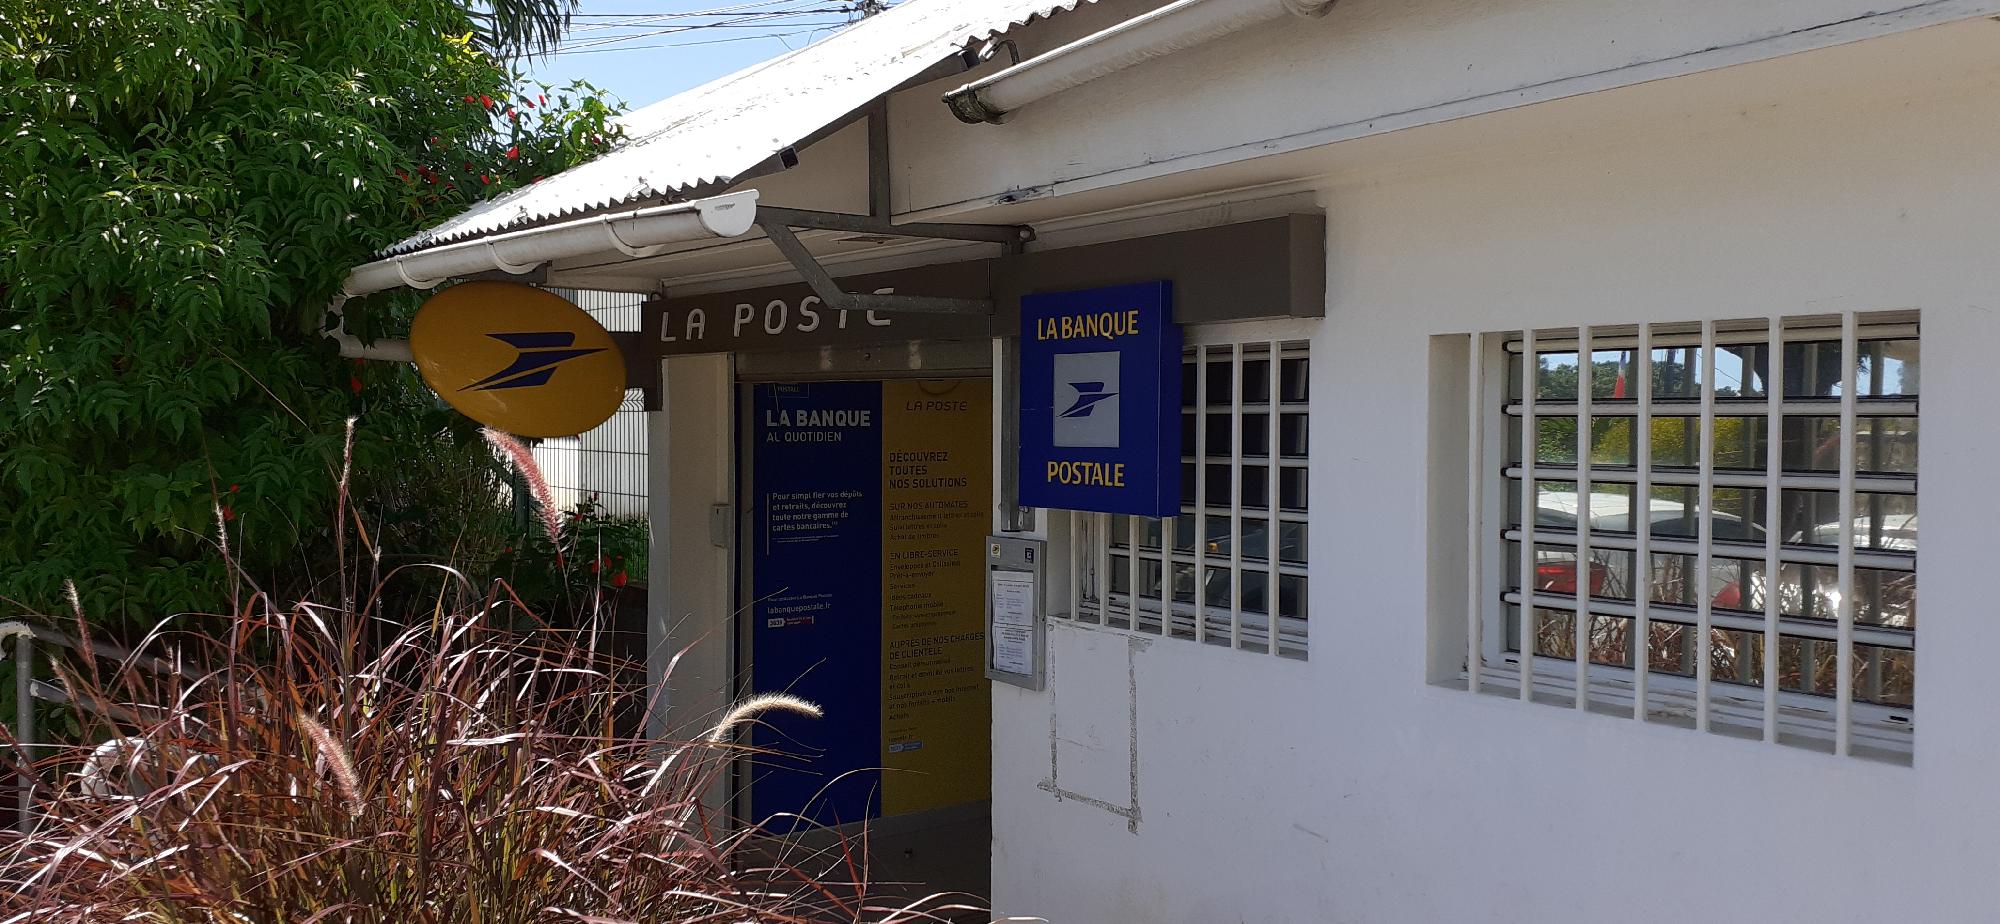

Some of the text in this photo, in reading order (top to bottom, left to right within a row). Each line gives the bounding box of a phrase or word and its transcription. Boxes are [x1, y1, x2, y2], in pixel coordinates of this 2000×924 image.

[660, 308, 706, 342] LA
[1037, 310, 1139, 340] LA BANQUE
[906, 400, 968, 411] LA POSTE
[766, 409, 871, 427] LA BANQUE
[784, 431, 842, 443] QUOTIDIEN
[889, 465, 928, 476] TOUTES
[1047, 461, 1125, 487] POSTALE
[889, 477, 968, 489] NOS SOLUTIONS
[772, 492, 790, 501] Pour
[890, 503, 906, 511] SUR
[772, 510, 849, 521] toute notre gamme de
[772, 523, 796, 531] cartes
[890, 552, 901, 560] EN
